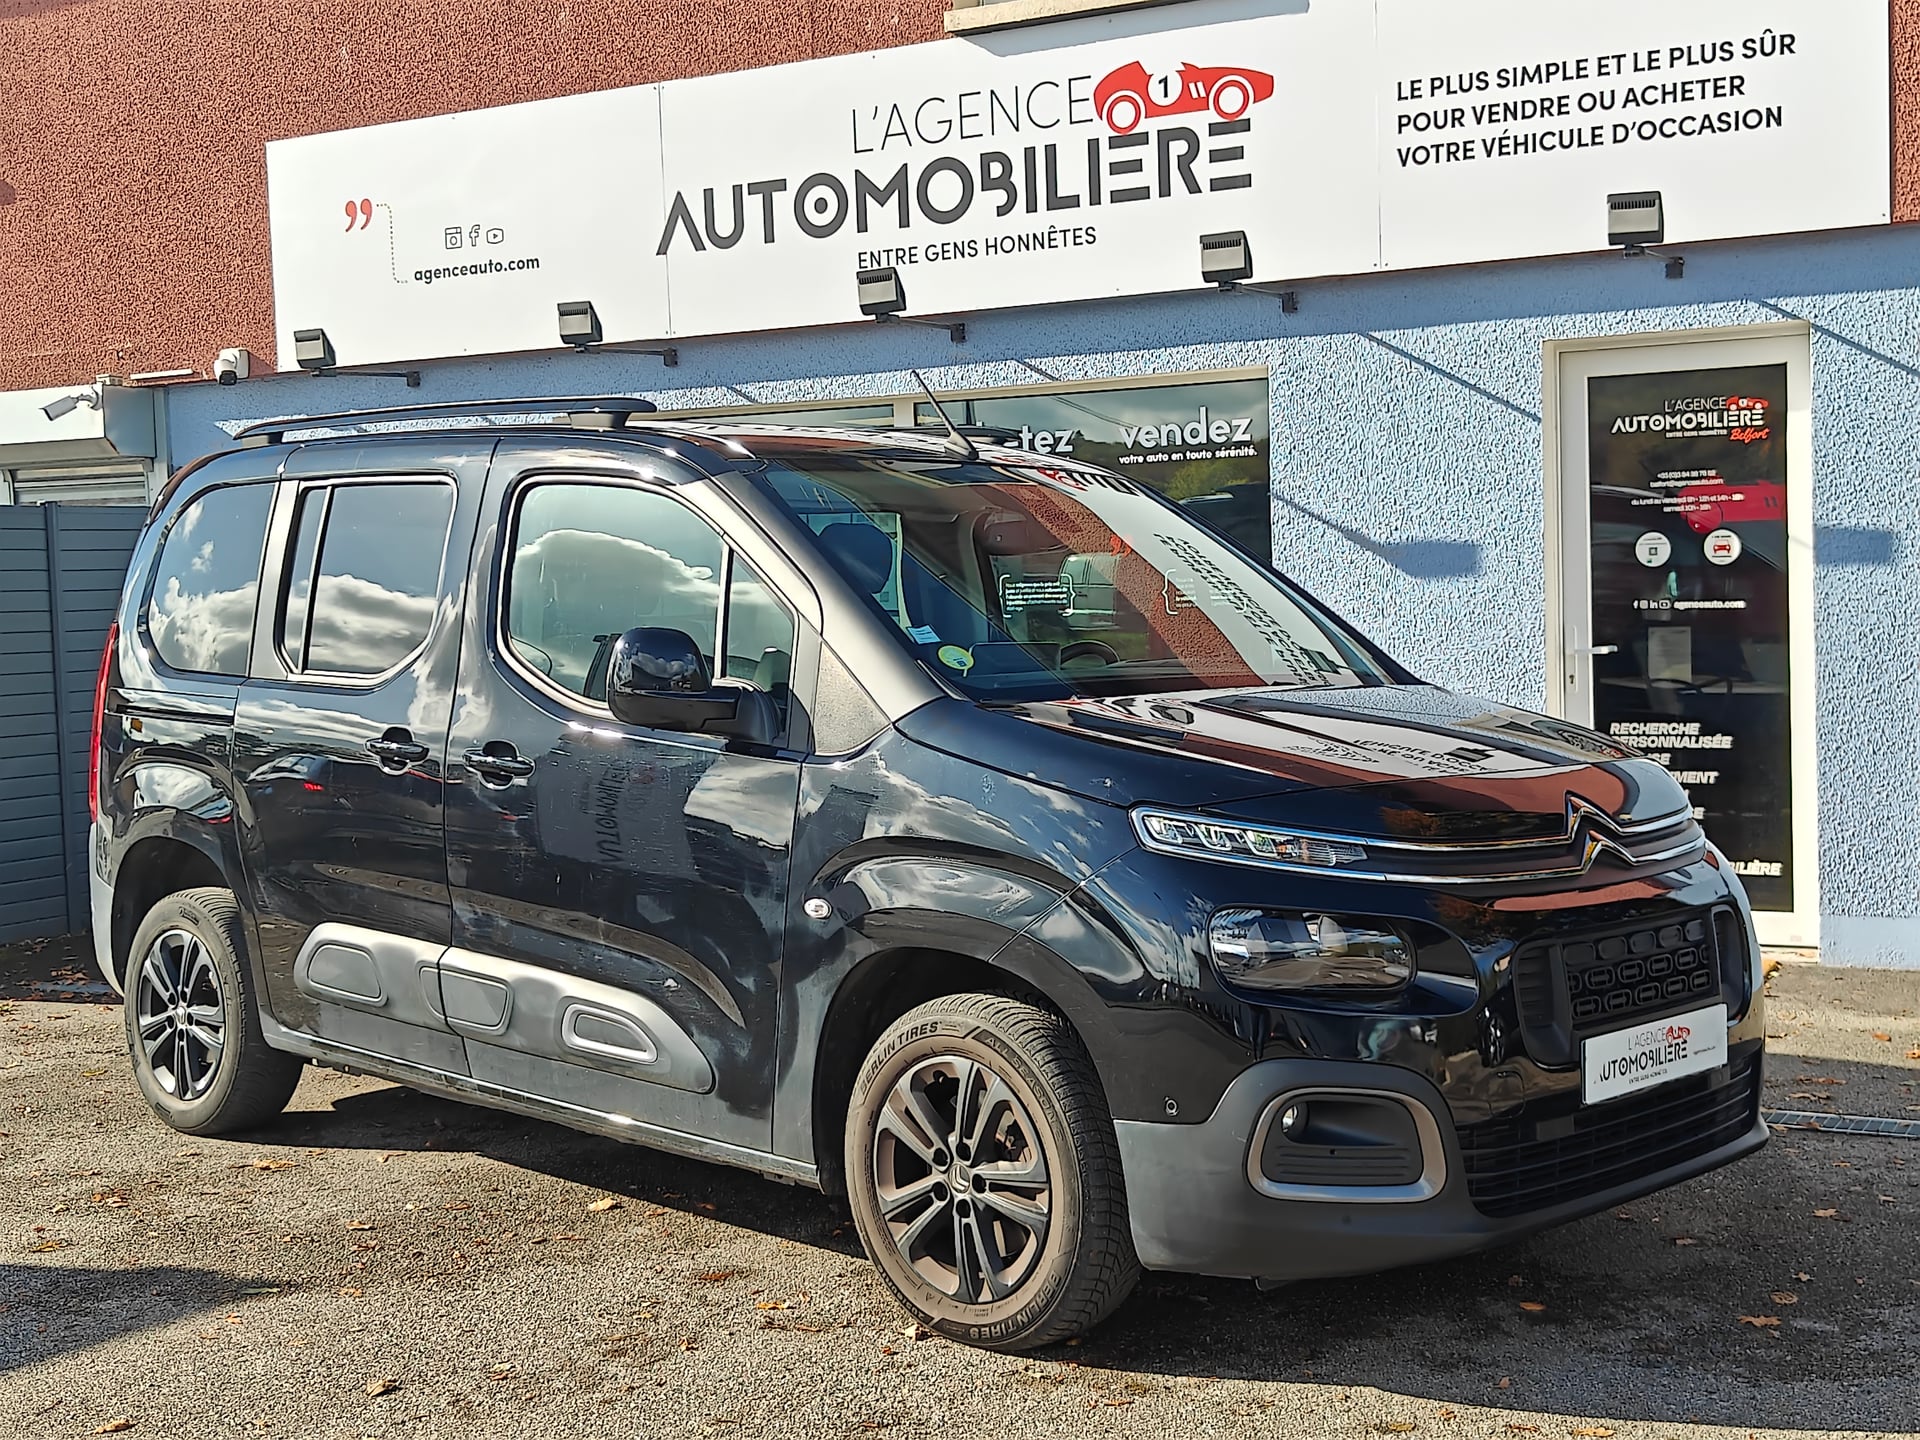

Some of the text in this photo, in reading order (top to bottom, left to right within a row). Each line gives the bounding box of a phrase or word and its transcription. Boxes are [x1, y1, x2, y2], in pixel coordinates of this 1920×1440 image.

[1397, 29, 1796, 101] LE PLUS SIMPLE ET LE PLUS SÛR
[852, 74, 1094, 153] L'AGENCE
[1397, 75, 1745, 134] POUR VENDRE OU ACHETER
[1396, 106, 1782, 167] VOTRE VÉHICULE D'OCCASION
[858, 225, 1097, 269] ENTRE GENS HONNÊTES
[414, 257, 540, 284] agenceauto.com
[1665, 396, 1727, 413] L'AGENCE
[1118, 407, 1252, 450] vendez
[1730, 427, 1770, 445] Belfort
[1119, 453, 1144, 464] votre
[1146, 452, 1169, 463] auto
[1171, 451, 1184, 461] en
[1186, 449, 1213, 460] toute
[1610, 722, 1701, 736] RECHERCHE
[898, 1020, 939, 1046] TIRES
[1627, 1026, 1667, 1051] LAGENCE
